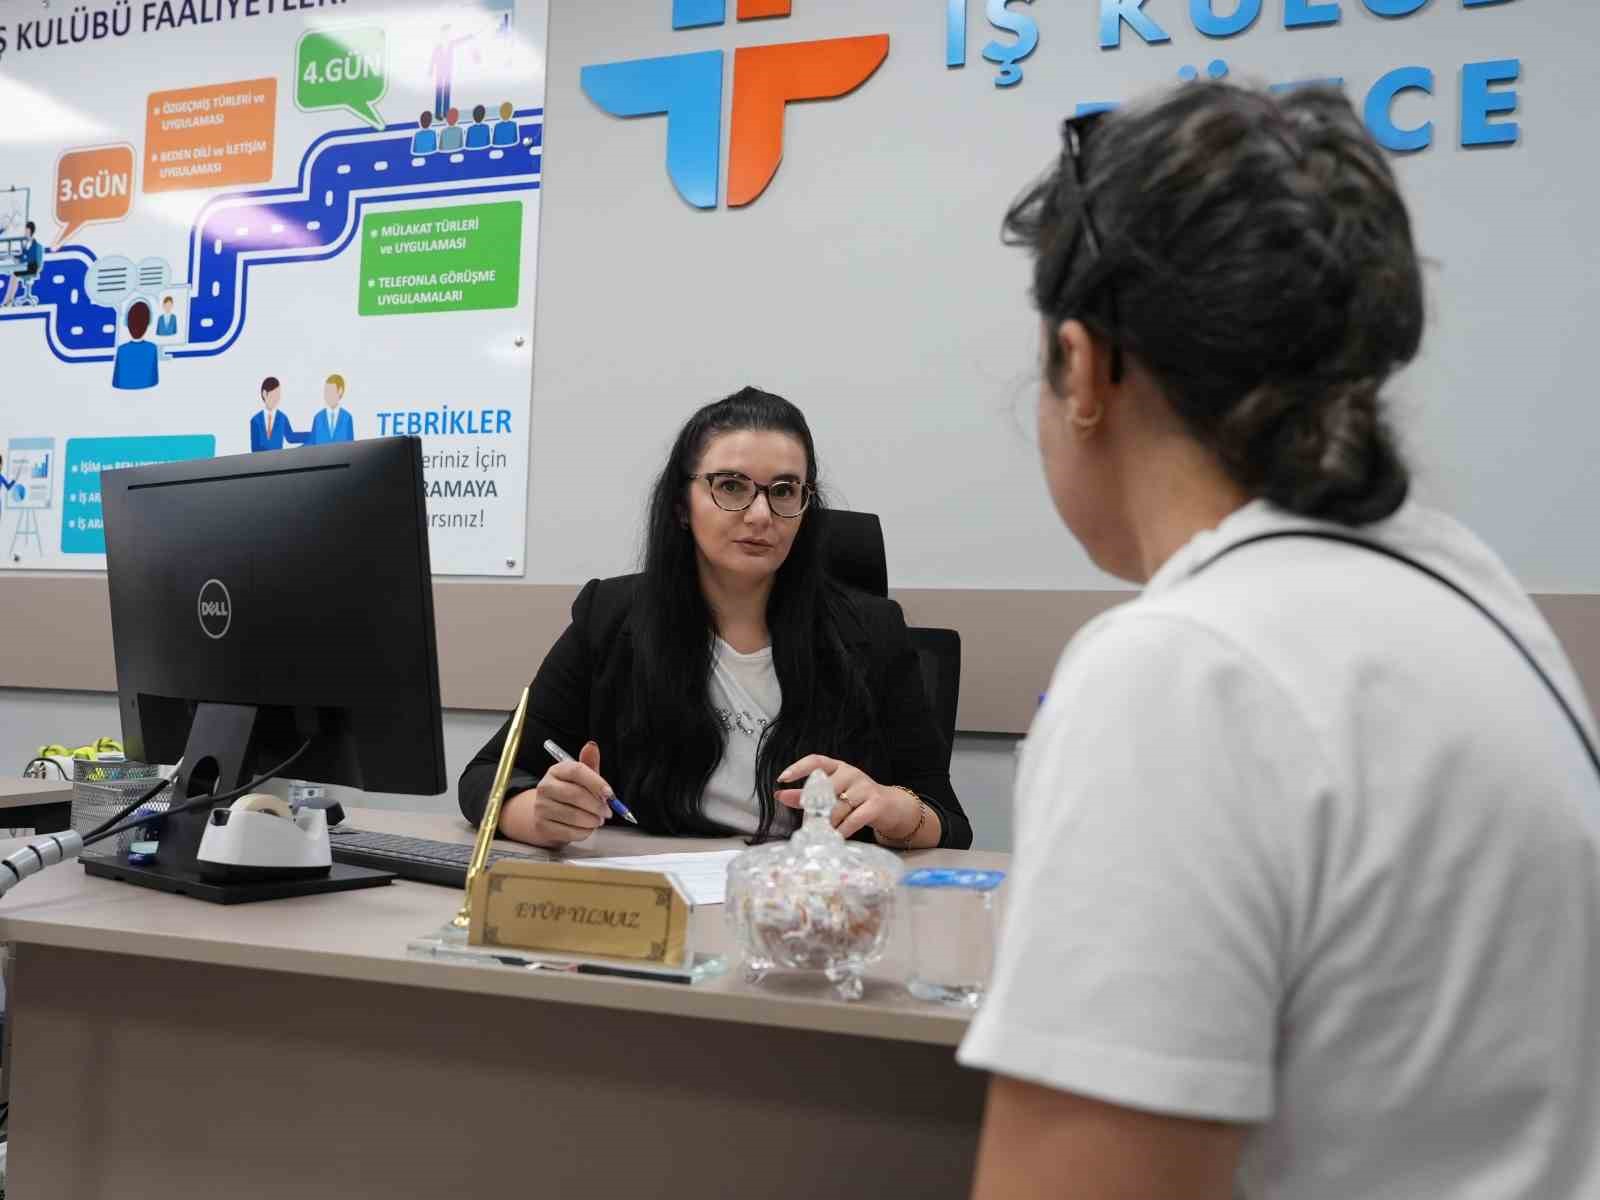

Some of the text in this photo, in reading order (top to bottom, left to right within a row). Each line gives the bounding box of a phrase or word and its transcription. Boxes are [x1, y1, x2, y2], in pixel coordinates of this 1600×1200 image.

[17, 0, 131, 50] KULÜBÜ
[303, 50, 381, 84] 4.GÜN
[60, 170, 128, 202] 3.GÜN
[381, 216, 480, 237] MÜLAKAT TÜRLERİ
[380, 238, 466, 255] ve UYGULAMASI
[378, 268, 496, 289] TELEFONLA GÖRÜŞME
[377, 290, 463, 306] UYGULAMALARI
[376, 405, 512, 436] TEBRİKLER
[422, 446, 507, 472] eriniz İçin
[201, 601, 228, 616] DELL
